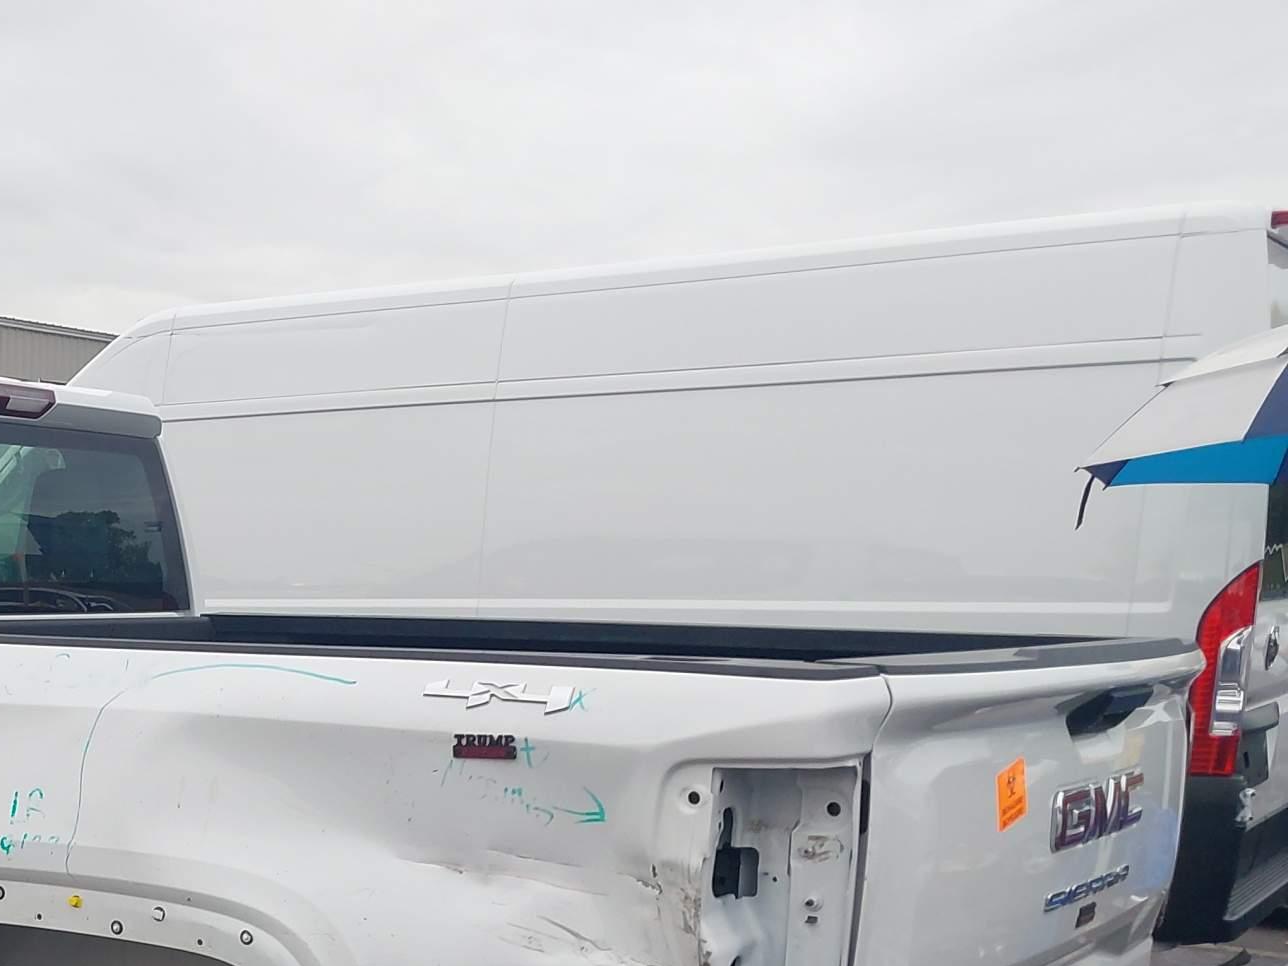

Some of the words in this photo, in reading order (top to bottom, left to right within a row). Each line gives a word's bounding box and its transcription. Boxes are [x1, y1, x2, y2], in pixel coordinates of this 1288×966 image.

[453, 734, 516, 747] TRUMP
[1050, 768, 1144, 853] GMC
[1044, 864, 1130, 912] SIERRA
